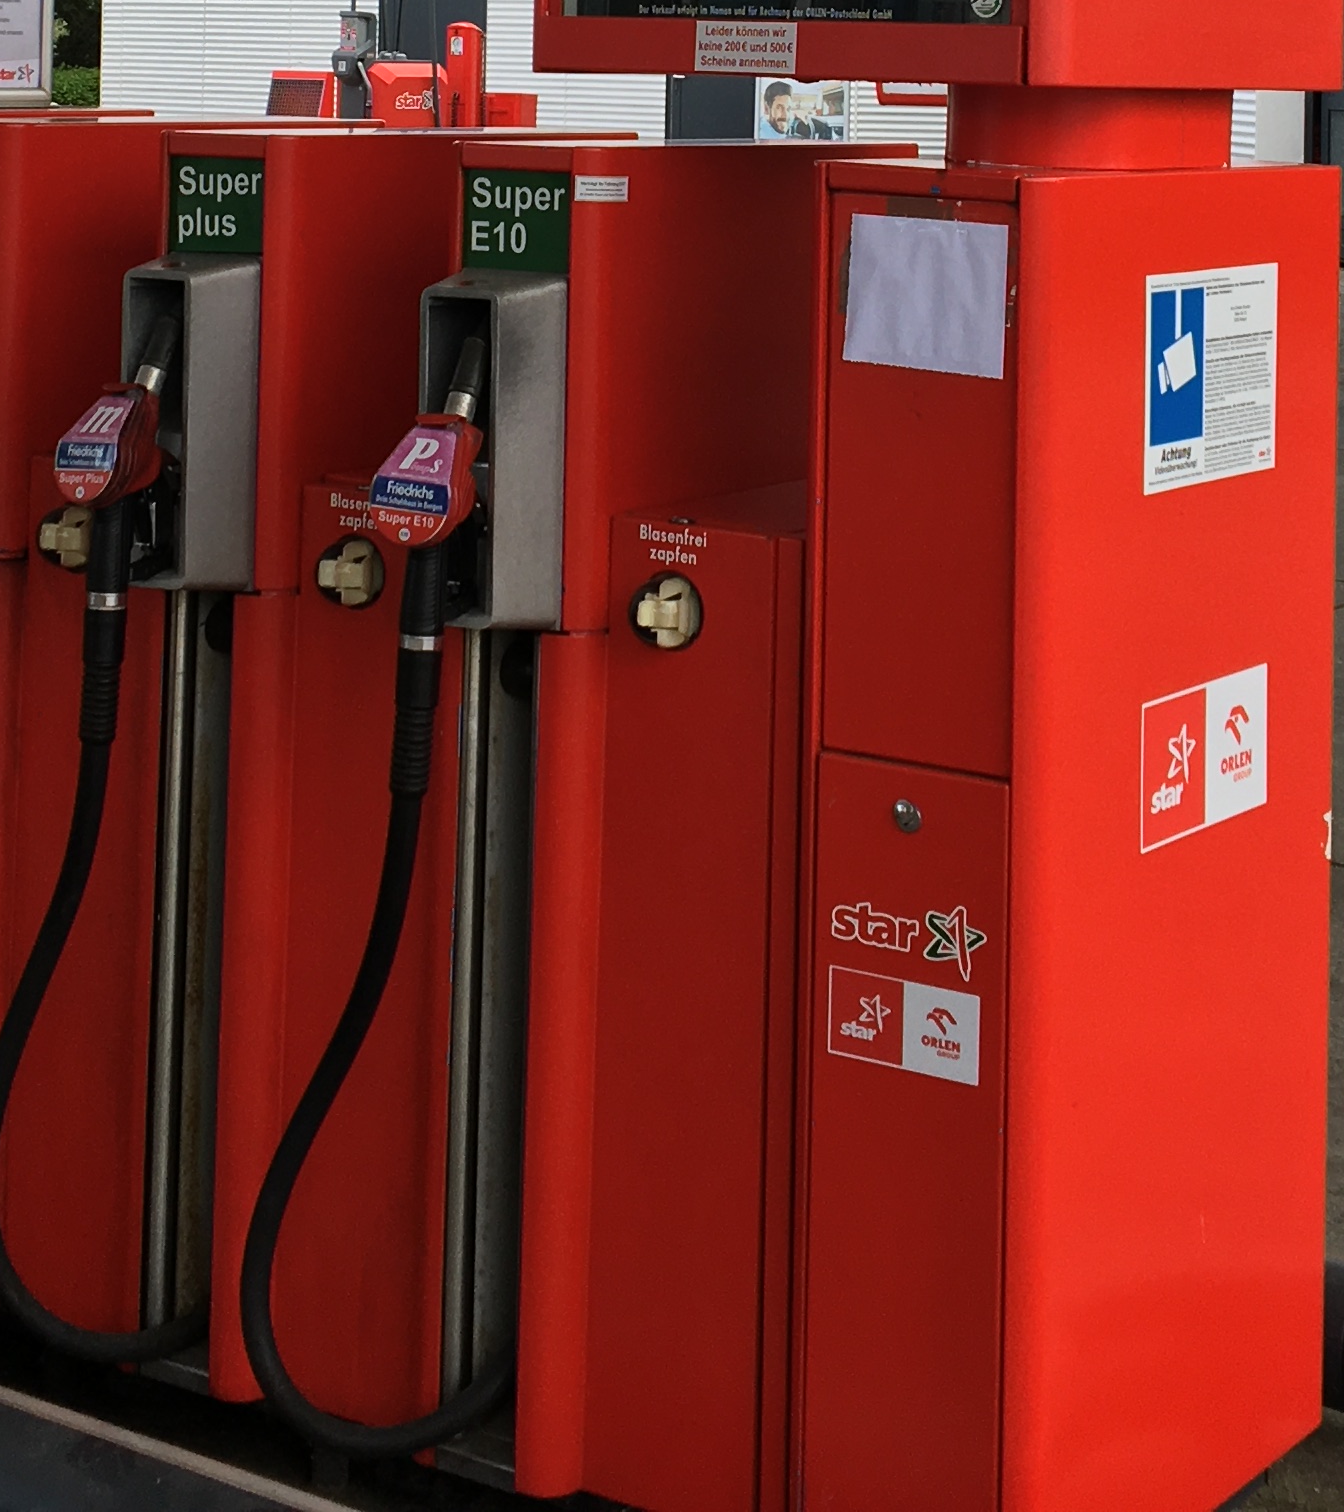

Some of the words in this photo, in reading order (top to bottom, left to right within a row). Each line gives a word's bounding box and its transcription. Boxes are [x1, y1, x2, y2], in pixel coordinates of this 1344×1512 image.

[733, 6, 746, 16] und
[792, 7, 804, 17] der
[705, 25, 734, 37] Leider
[735, 25, 770, 38] können
[771, 27, 787, 38] wir
[699, 40, 723, 52] keine
[750, 41, 768, 53] und
[701, 55, 737, 67] Scheine
[739, 57, 790, 69] annehmen.
[396, 91, 422, 109] star
[178, 165, 262, 199] Super
[471, 176, 565, 217] Super
[177, 206, 237, 244] plus
[471, 220, 527, 254] E10
[1160, 446, 1192, 463] Achtung
[59, 472, 84, 485] Super
[85, 472, 104, 484] Plus
[386, 480, 435, 500] Friedrichs
[330, 492, 371, 511] Blasen
[378, 510, 411, 526] Super
[413, 514, 435, 529] E10
[639, 523, 707, 548] Blasenfrei
[649, 545, 697, 566] zapfen
[1220, 748, 1252, 775] ORLEN
[1151, 782, 1184, 815] star
[831, 902, 919, 952] star
[840, 1020, 877, 1042] star
[920, 1034, 961, 1054] ORLEN
